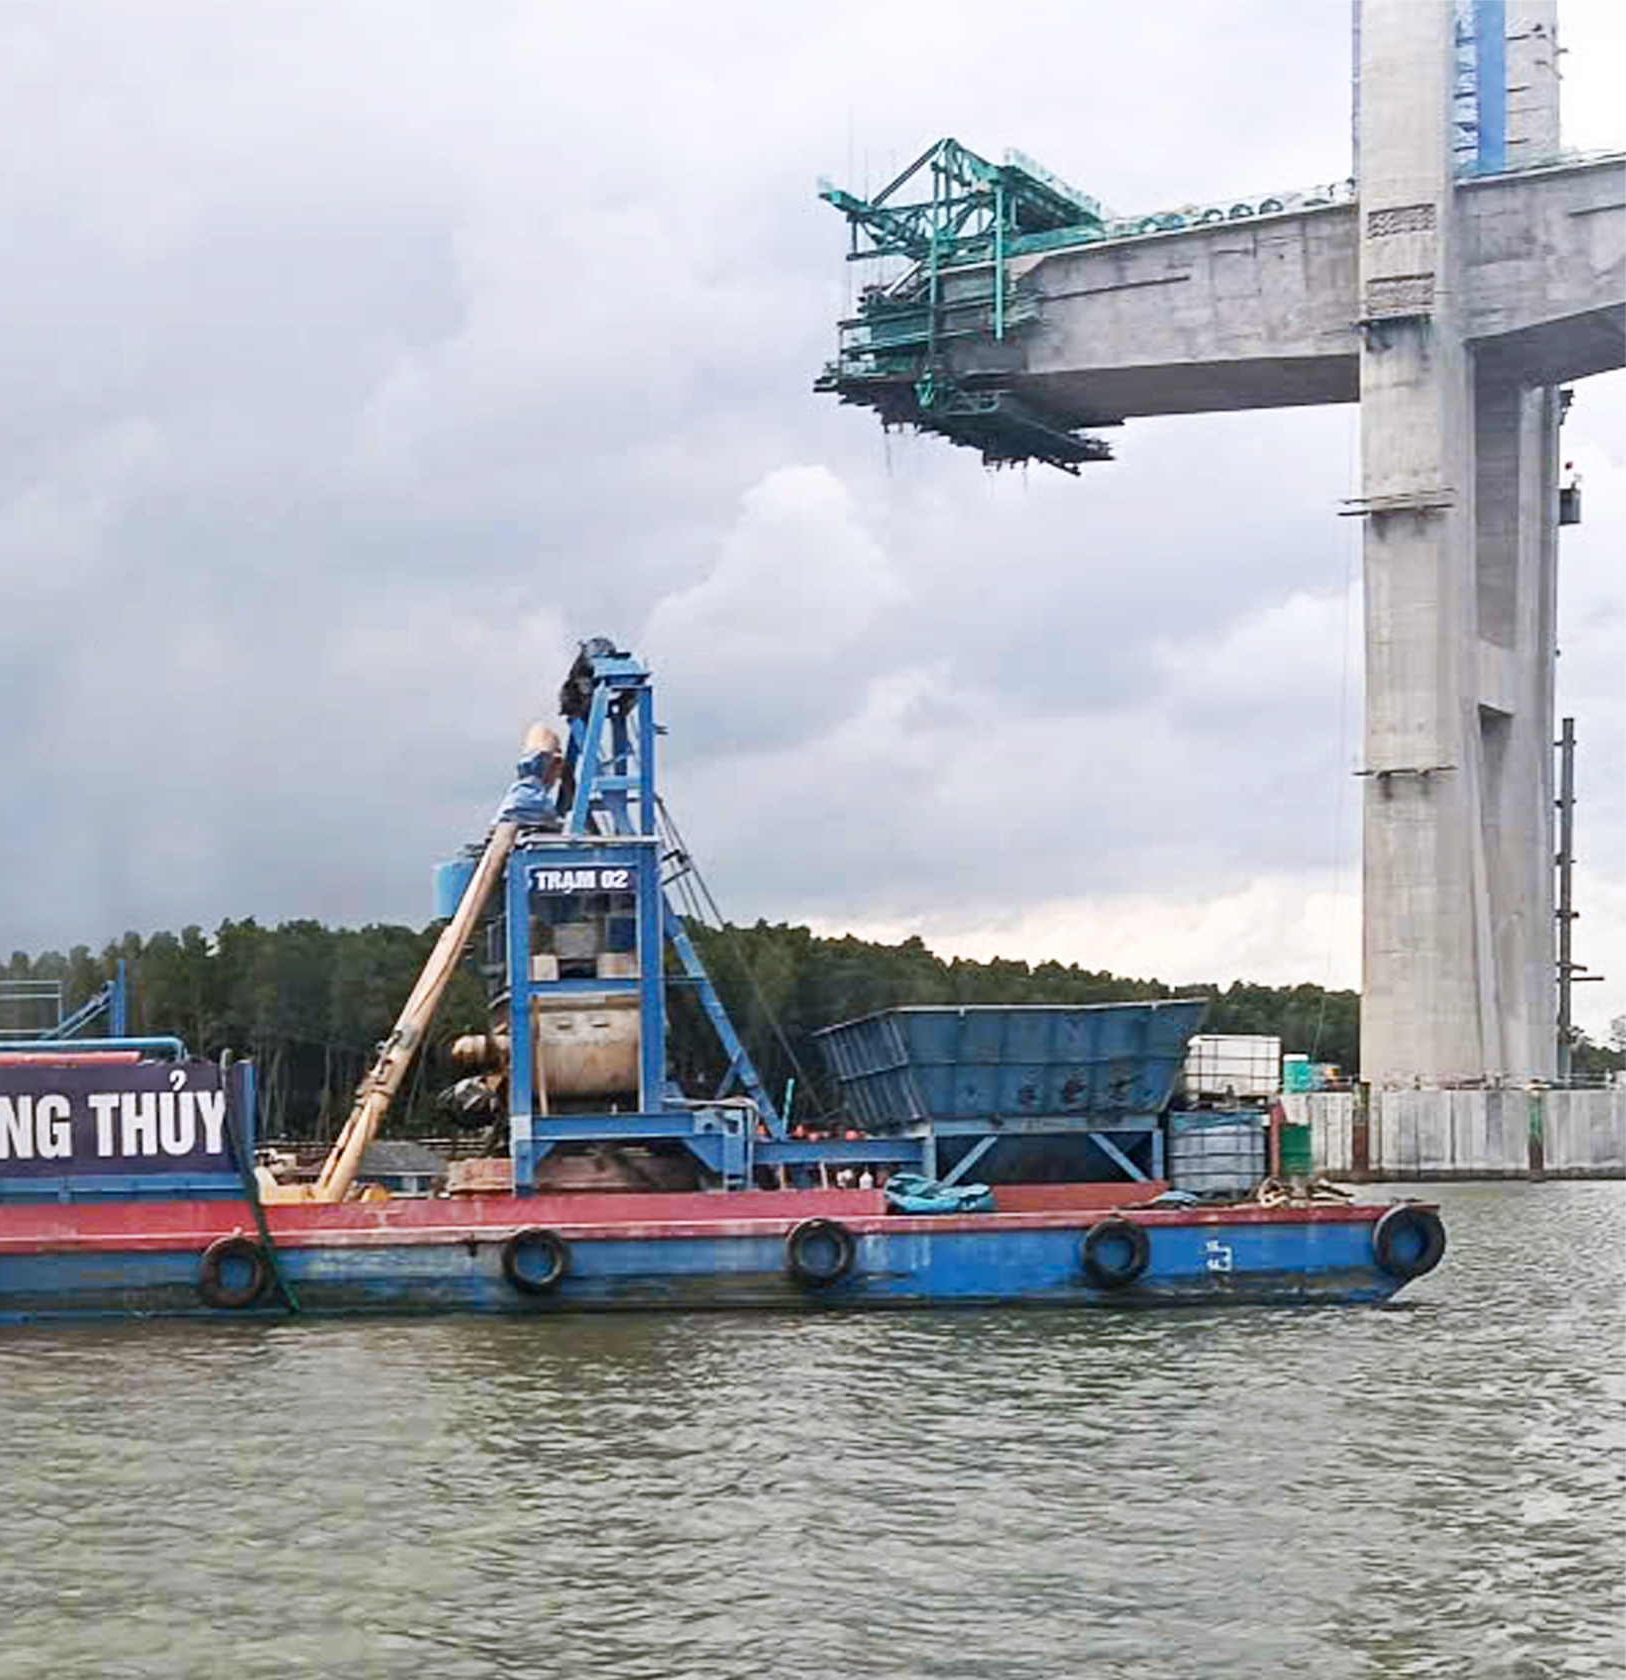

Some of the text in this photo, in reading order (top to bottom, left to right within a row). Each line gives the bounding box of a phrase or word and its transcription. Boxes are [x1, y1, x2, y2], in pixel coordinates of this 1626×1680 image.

[535, 870, 628, 894] TRẠM 02
[88, 1069, 226, 1157] THỦY
